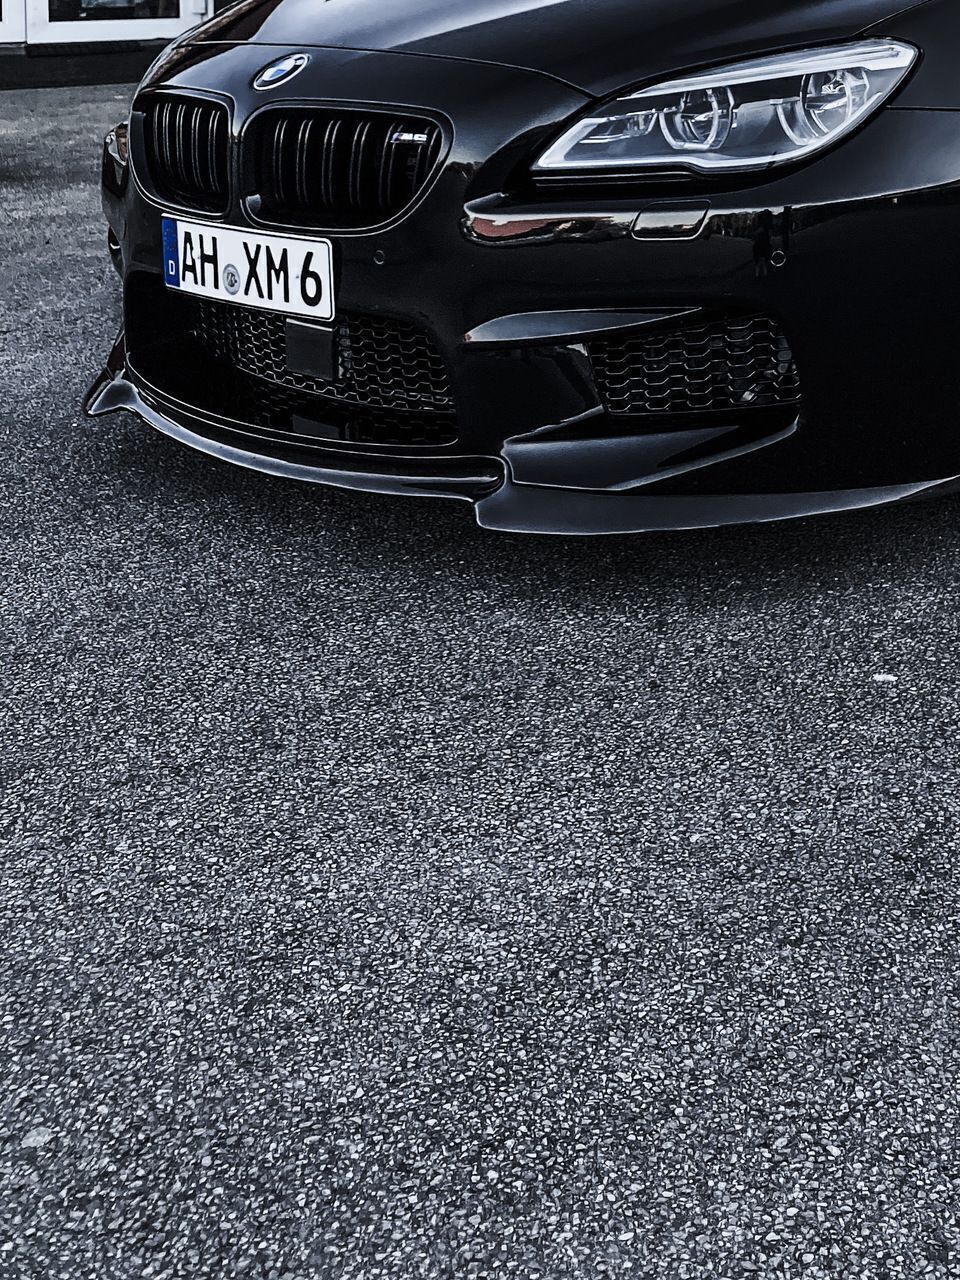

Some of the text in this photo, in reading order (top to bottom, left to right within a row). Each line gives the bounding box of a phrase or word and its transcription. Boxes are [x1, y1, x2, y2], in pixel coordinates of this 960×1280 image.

[168, 260, 176, 276] D
[182, 231, 322, 307] AH XM 6
